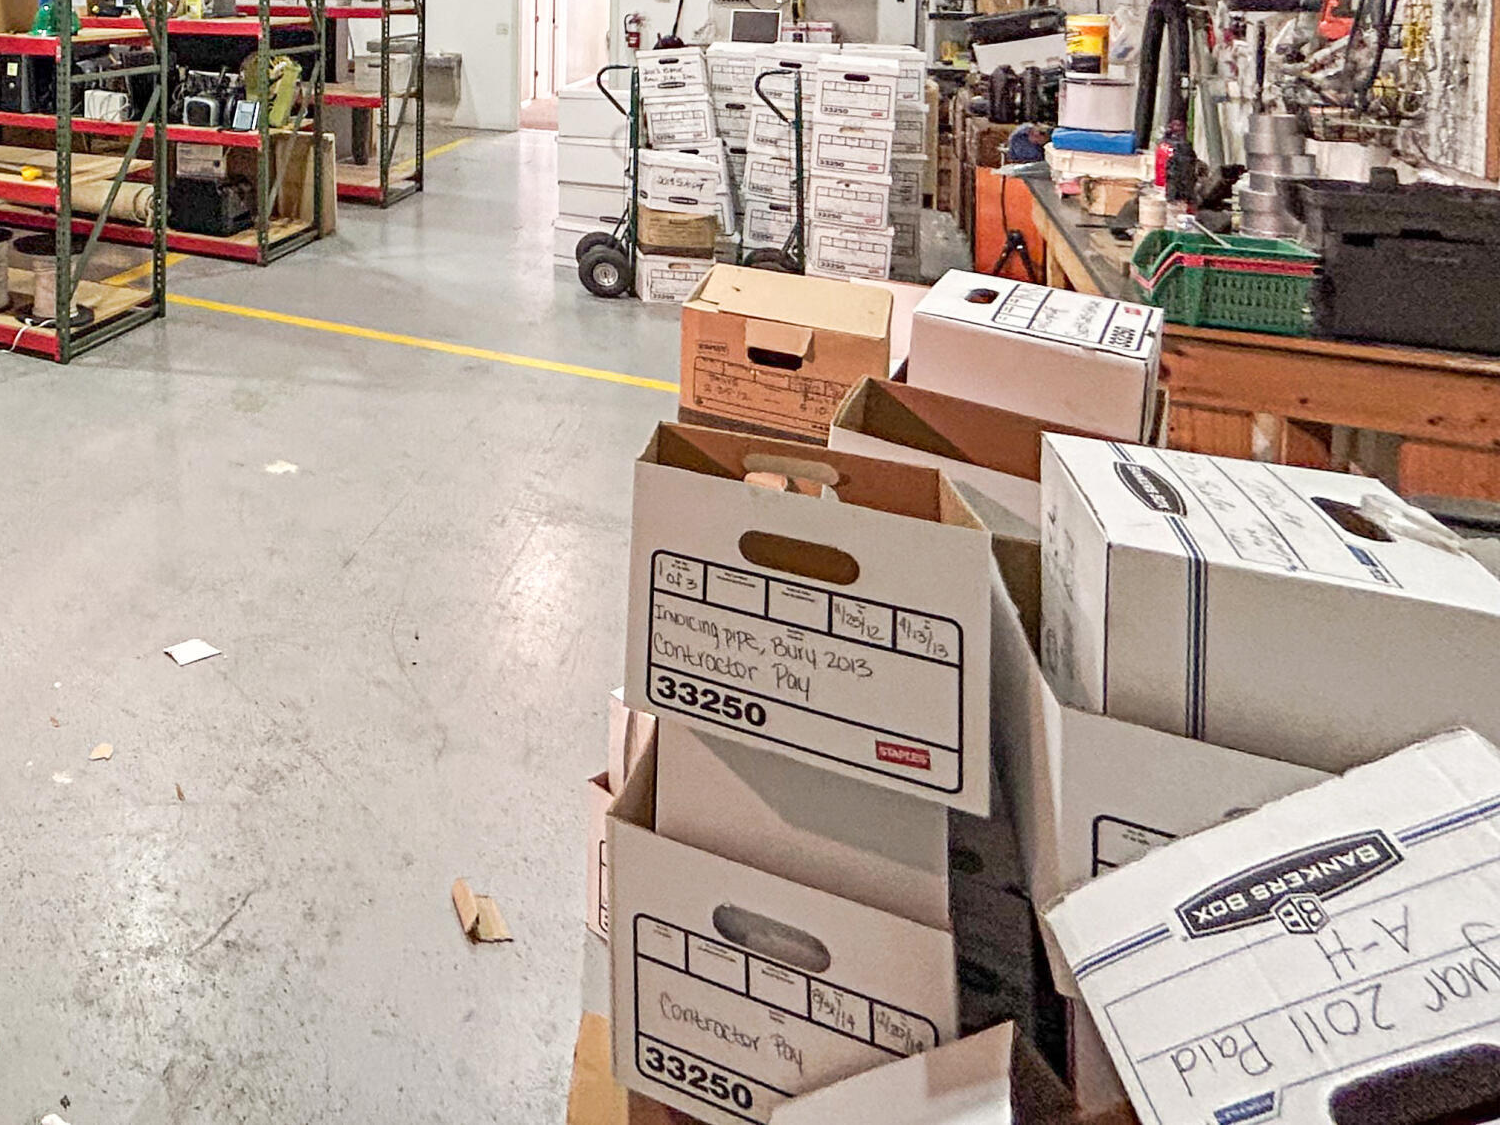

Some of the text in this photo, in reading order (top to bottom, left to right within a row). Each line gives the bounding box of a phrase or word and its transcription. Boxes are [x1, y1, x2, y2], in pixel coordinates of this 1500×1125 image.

[686, 578, 698, 590] 3
[654, 632, 810, 702] Contractor Pay
[824, 651, 874, 678] 2013
[657, 676, 767, 726] 33250
[1192, 843, 1381, 924] BANKERS BOX
[660, 992, 803, 1076] Contractor Pay
[1289, 983, 1395, 1053] 2011
[645, 1047, 753, 1110] 33250
[1170, 1023, 1274, 1097] Paid
